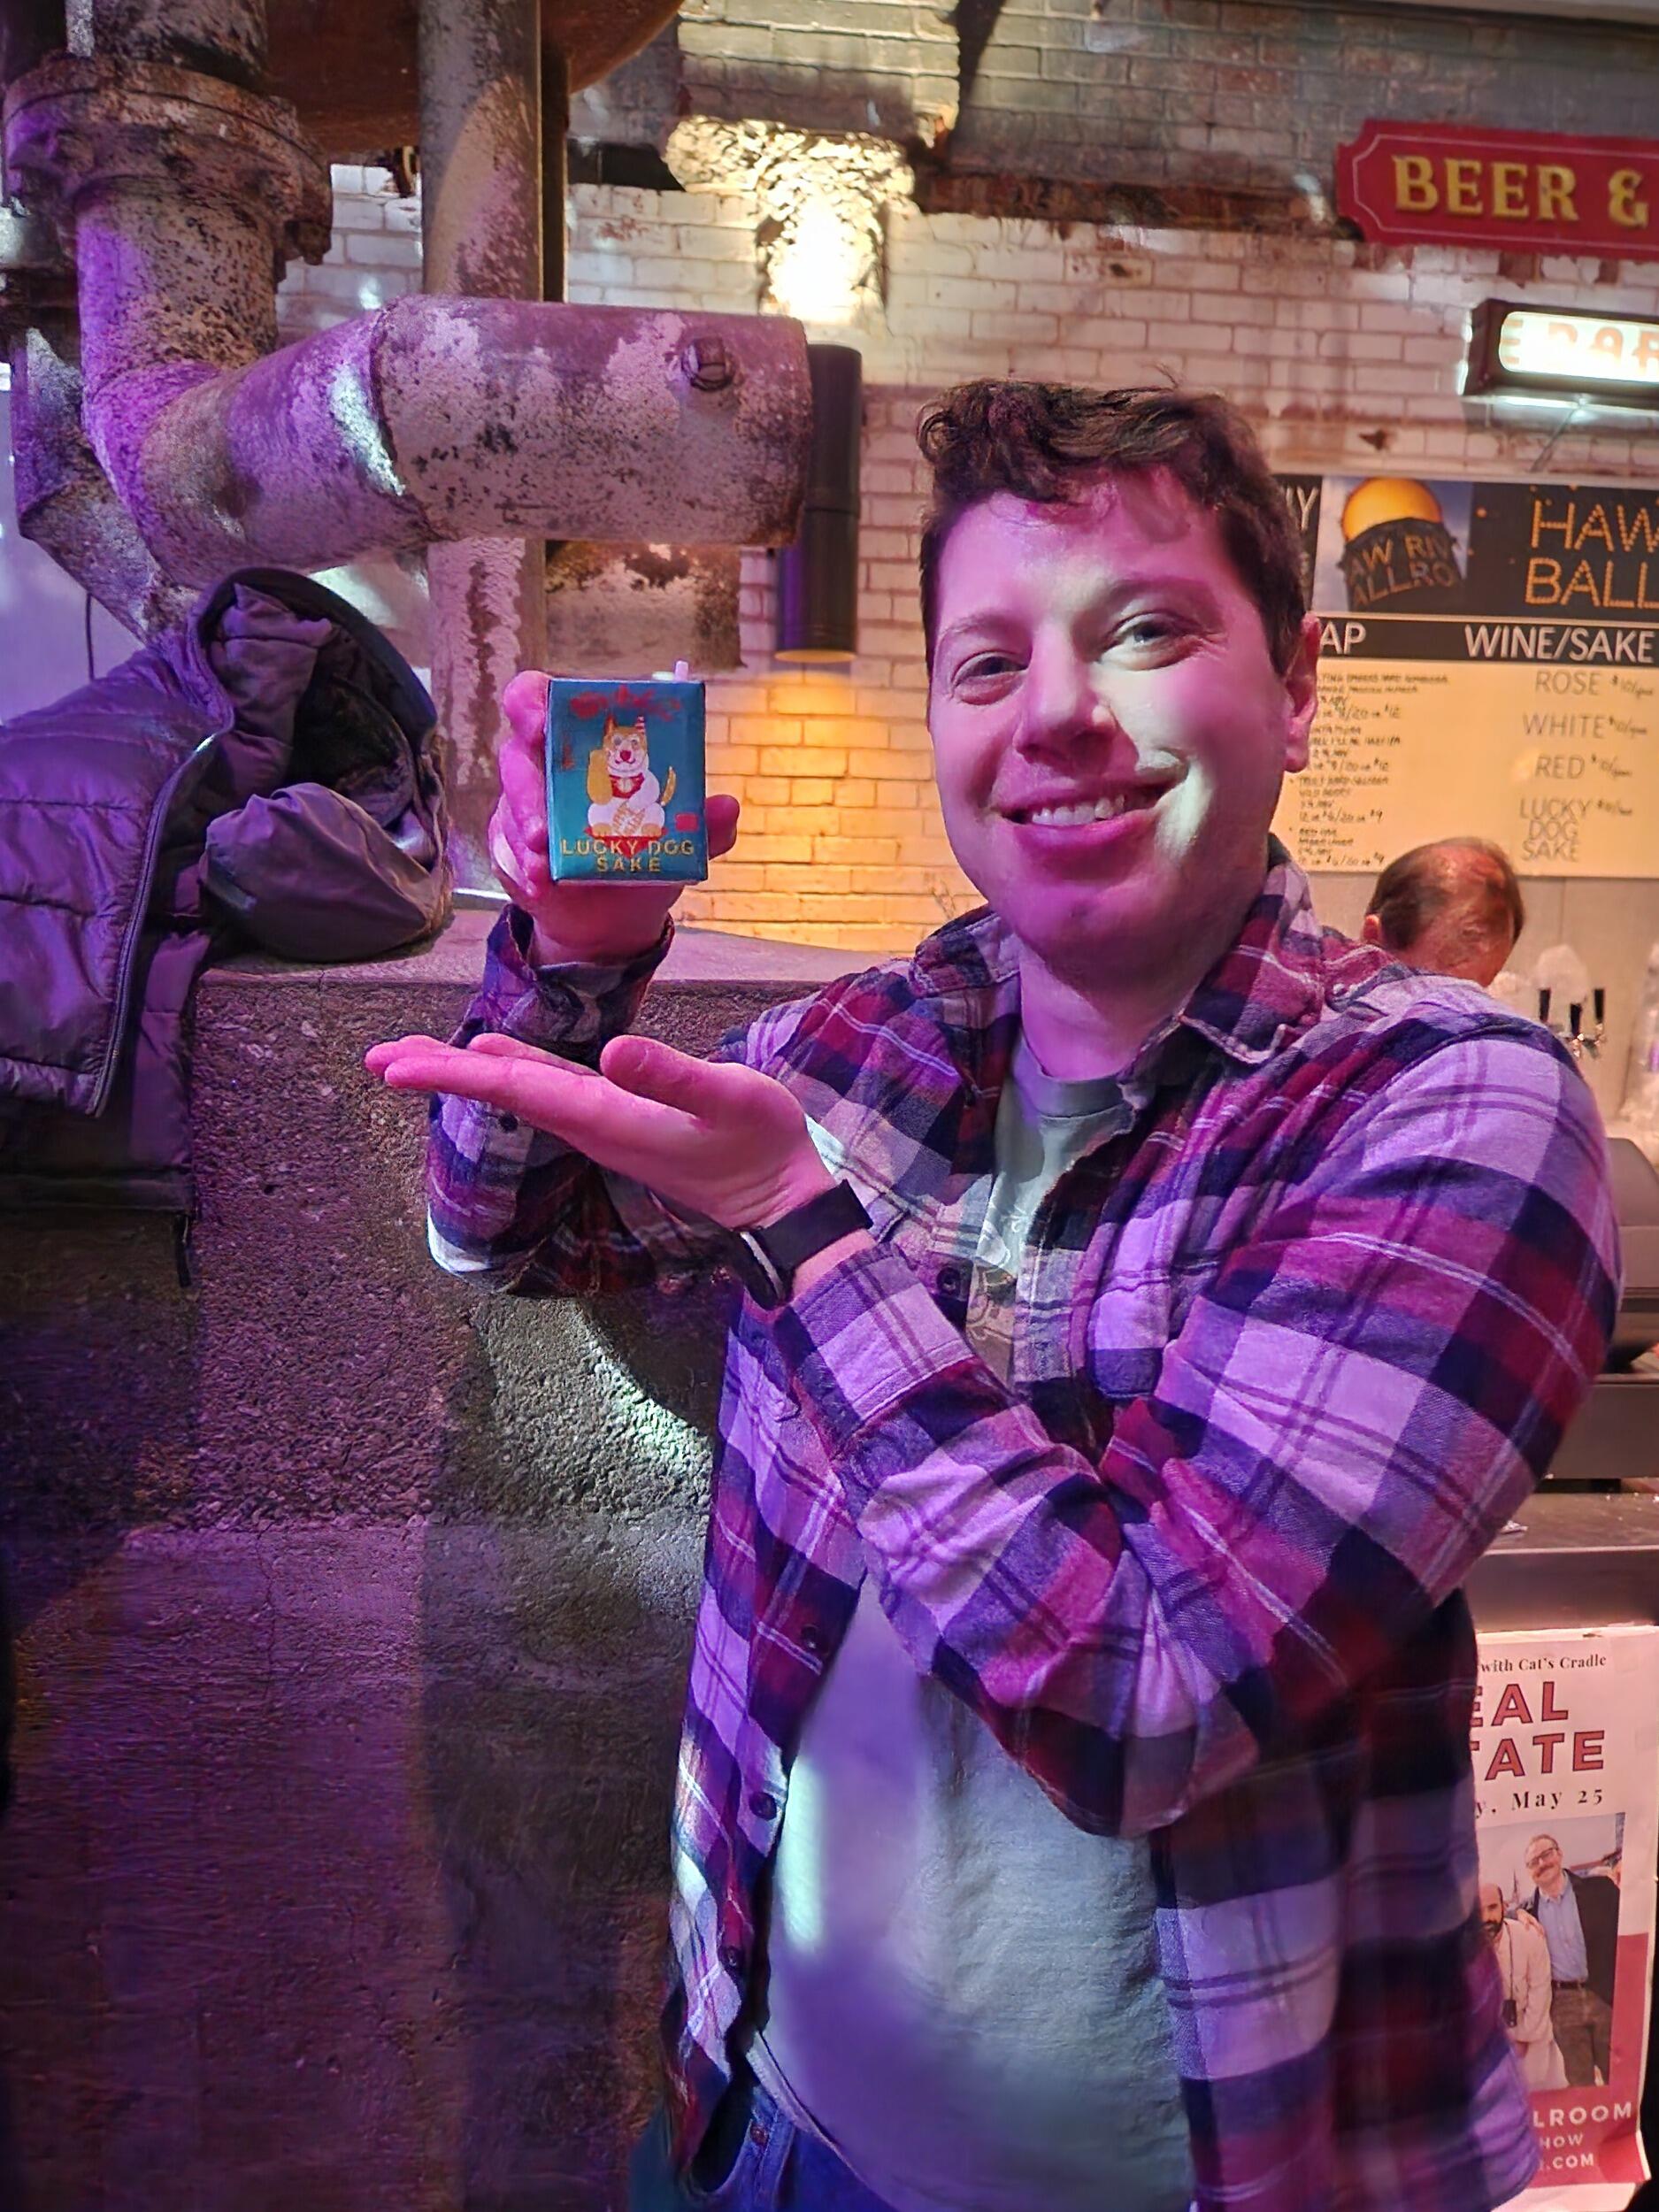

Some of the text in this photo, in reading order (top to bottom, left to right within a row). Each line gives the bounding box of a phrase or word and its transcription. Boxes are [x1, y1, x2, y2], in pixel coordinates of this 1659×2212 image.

[1391, 154, 1649, 227] BEER &
[1530, 498, 1659, 553] HAW
[1525, 557, 1659, 609] BALL
[1464, 623, 1655, 663] WINE/SAKE
[1535, 670, 1601, 695] ROSE
[1522, 711, 1606, 739] WHITE
[1534, 753, 1586, 780] RED
[1519, 797, 1592, 823] LUCKY
[1529, 819, 1578, 841] DOG
[561, 839, 695, 856] LUCKY DOG
[1521, 840, 1579, 863] SAKE
[596, 856, 661, 872] SAKE
[1480, 1654, 1607, 1673] with Cat's Cradle
[1511, 1791, 1563, 1810] May
[1578, 1789, 1603, 1806] 25
[1532, 2101, 1632, 2129] LROOM
